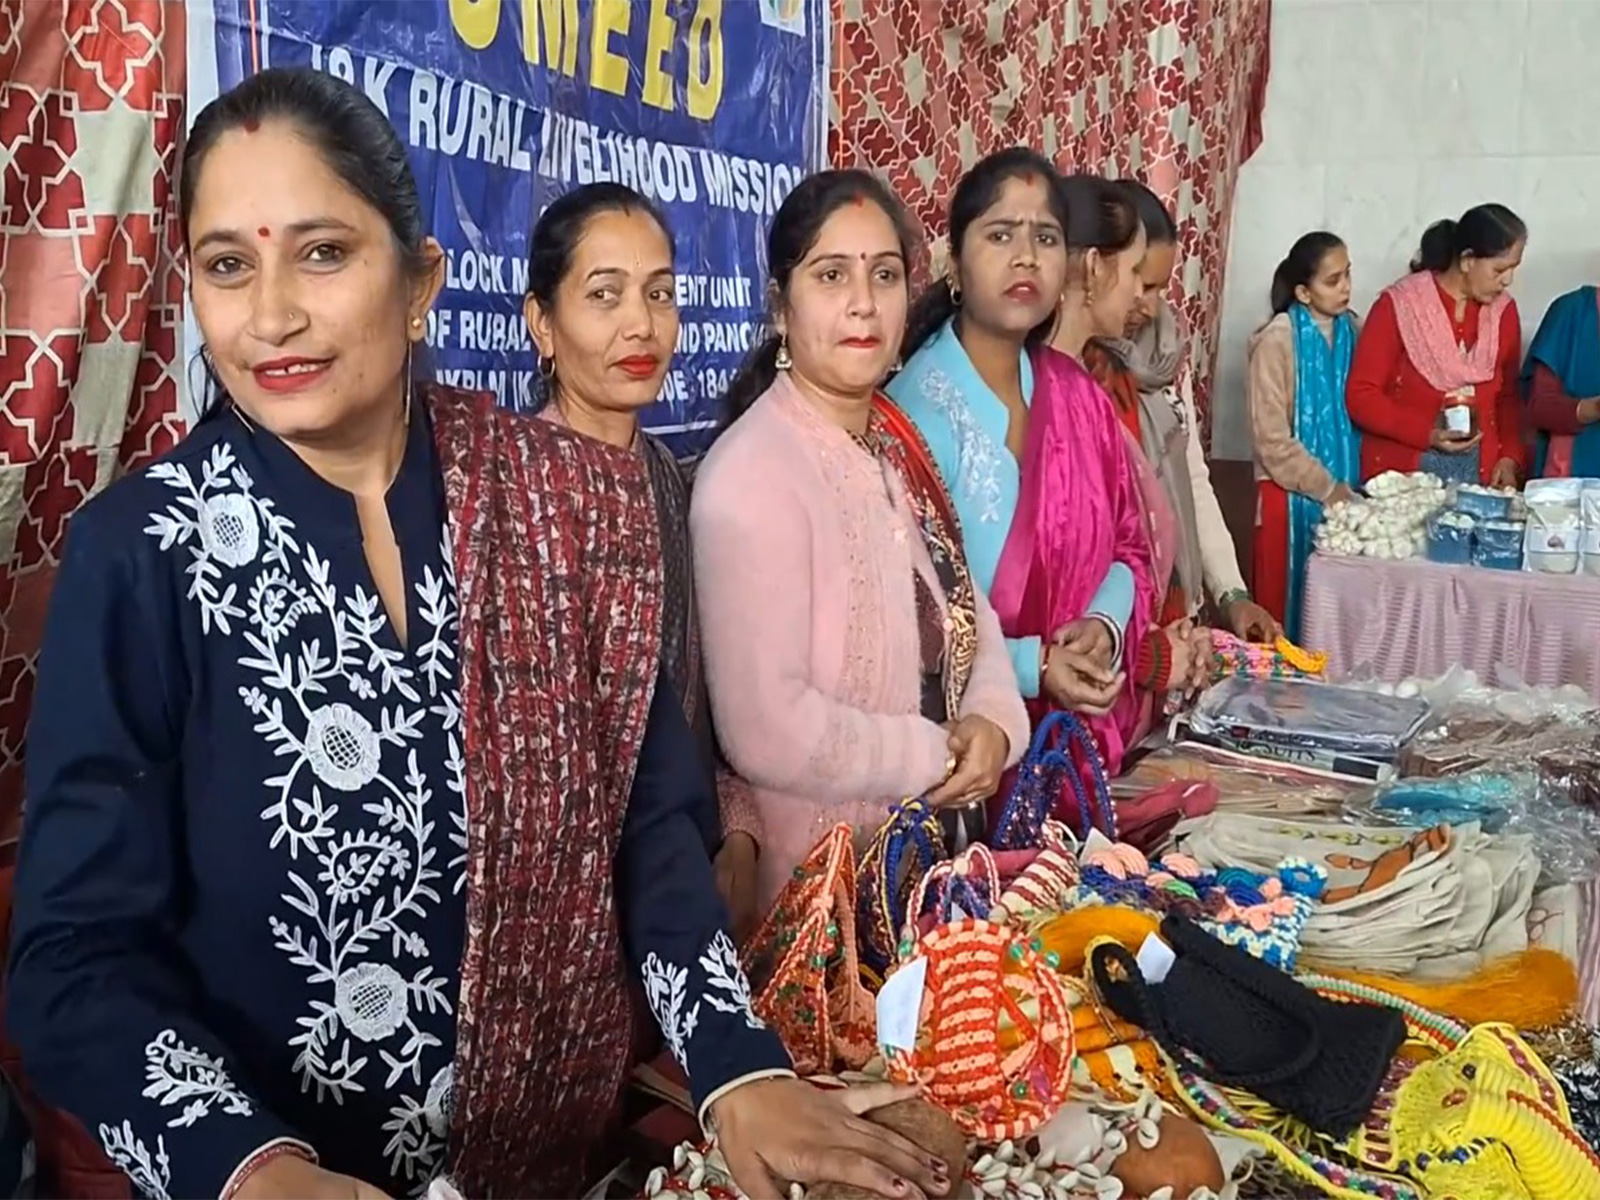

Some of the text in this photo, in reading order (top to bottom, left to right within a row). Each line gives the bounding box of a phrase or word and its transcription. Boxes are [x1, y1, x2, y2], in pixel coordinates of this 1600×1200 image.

[409, 68, 532, 171] RURAL
[538, 107, 698, 202] LIVELIHOOD
[446, 248, 508, 294] LOCK
[710, 276, 752, 308] UNIT
[424, 309, 452, 349] OF
[459, 310, 531, 352] RURAL
